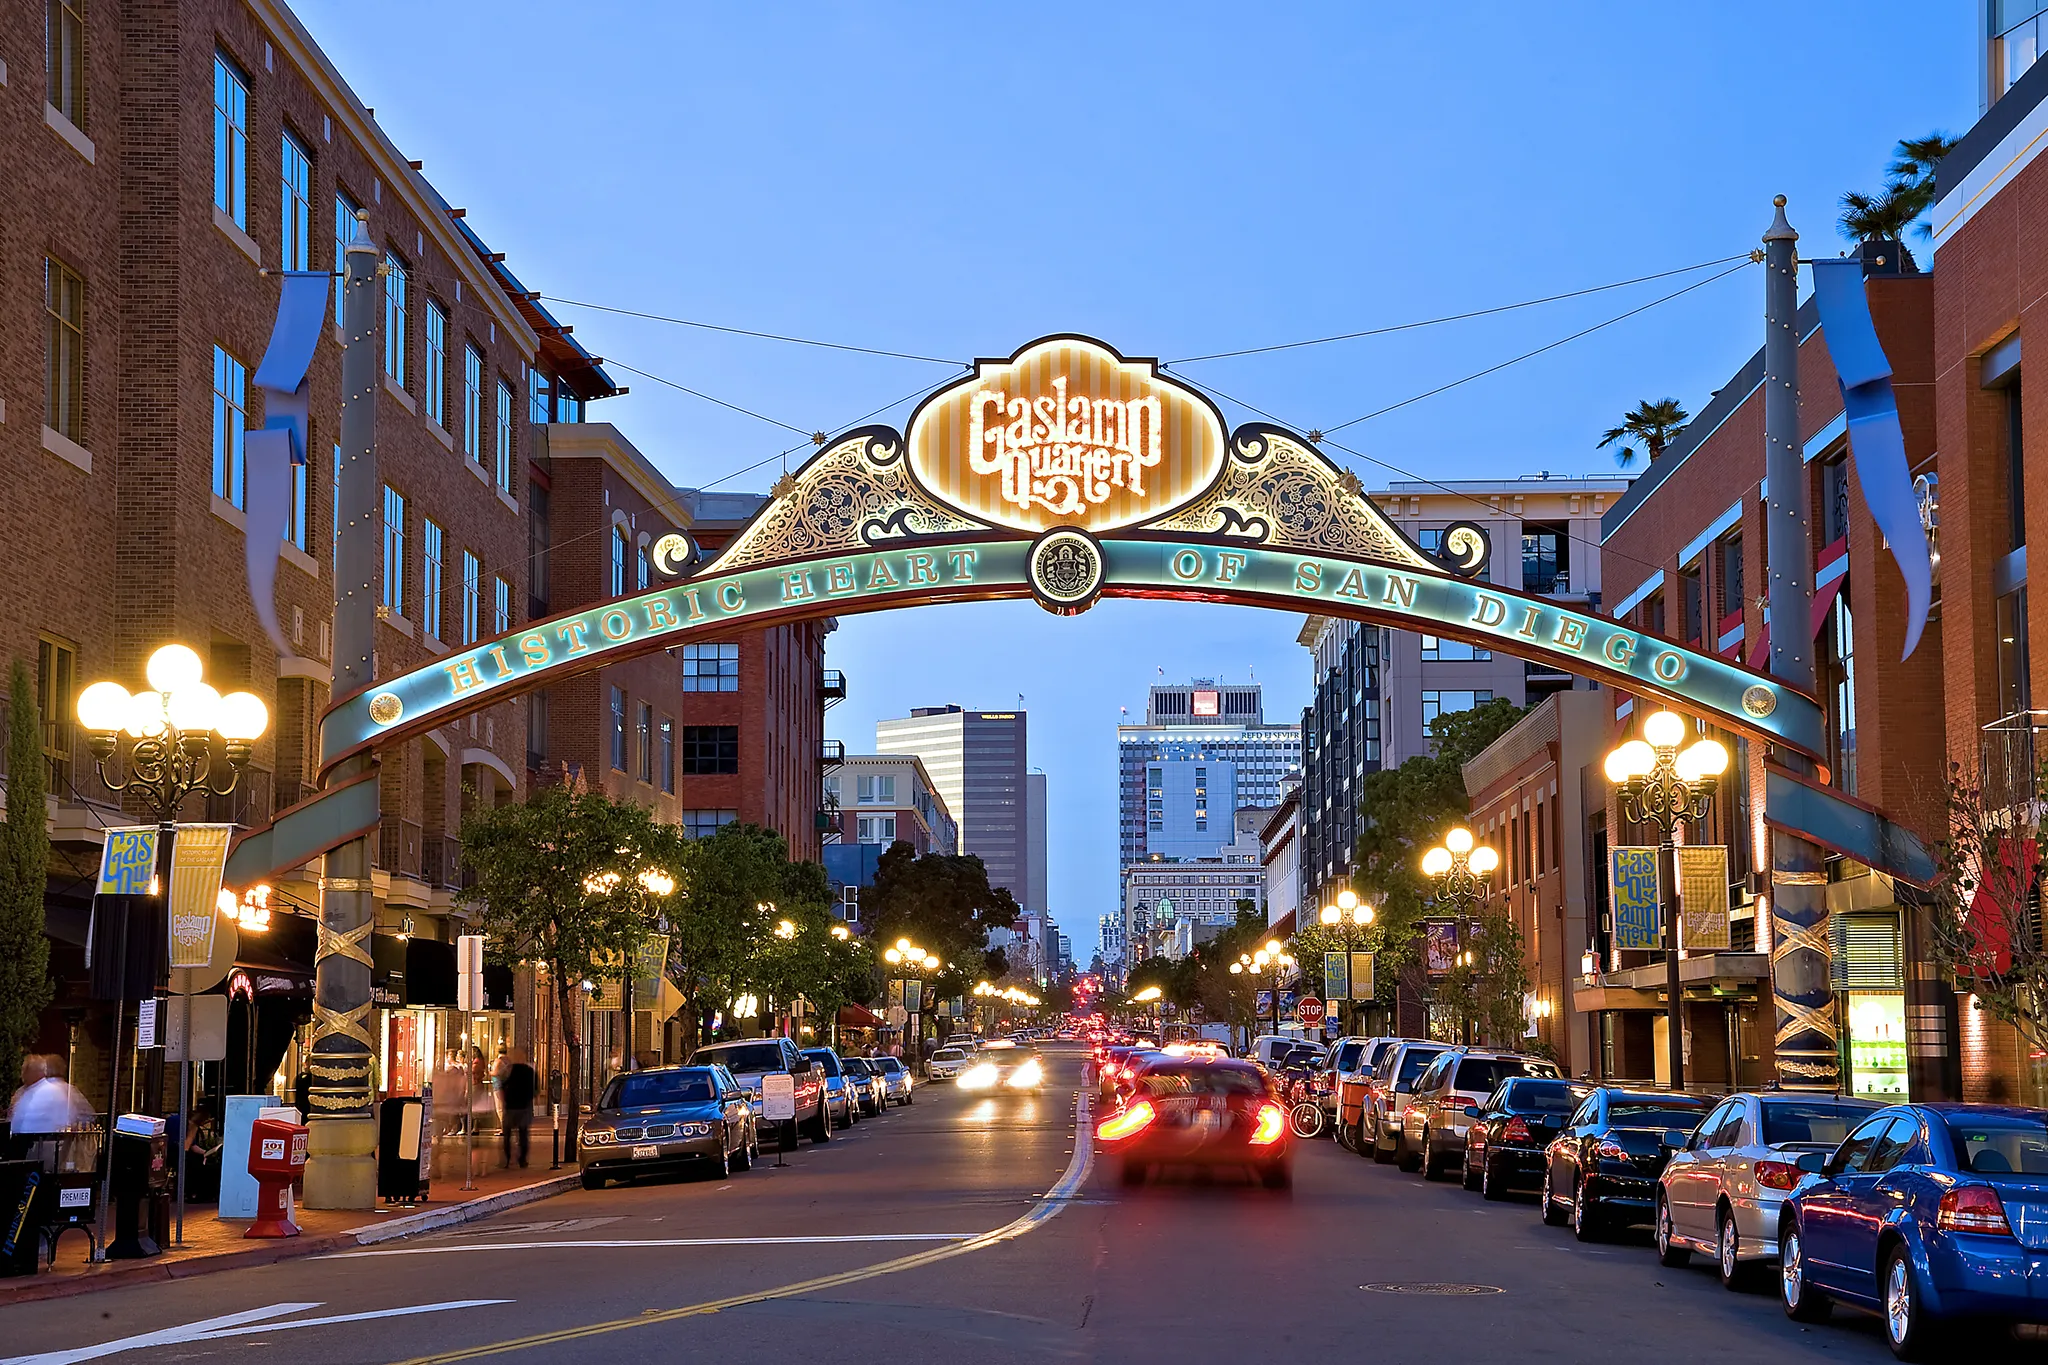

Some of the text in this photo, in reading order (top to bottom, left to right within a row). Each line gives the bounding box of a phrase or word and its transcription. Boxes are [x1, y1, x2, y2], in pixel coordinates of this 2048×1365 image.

[969, 375, 1162, 475] Gaslamp
[1001, 443, 1146, 515] Quarter
[445, 549, 1688, 696] HISTORIC HEART OF SAN DIEGO
[103, 832, 153, 882] Gas
[1613, 850, 1655, 887] Gas
[173, 911, 211, 937] Gaslamp
[1687, 909, 1725, 927] Gaslamp
[1300, 1005, 1322, 1015] STOP
[293, 1138, 307, 1150] 101
[62, 1192, 89, 1201] PREMIER
